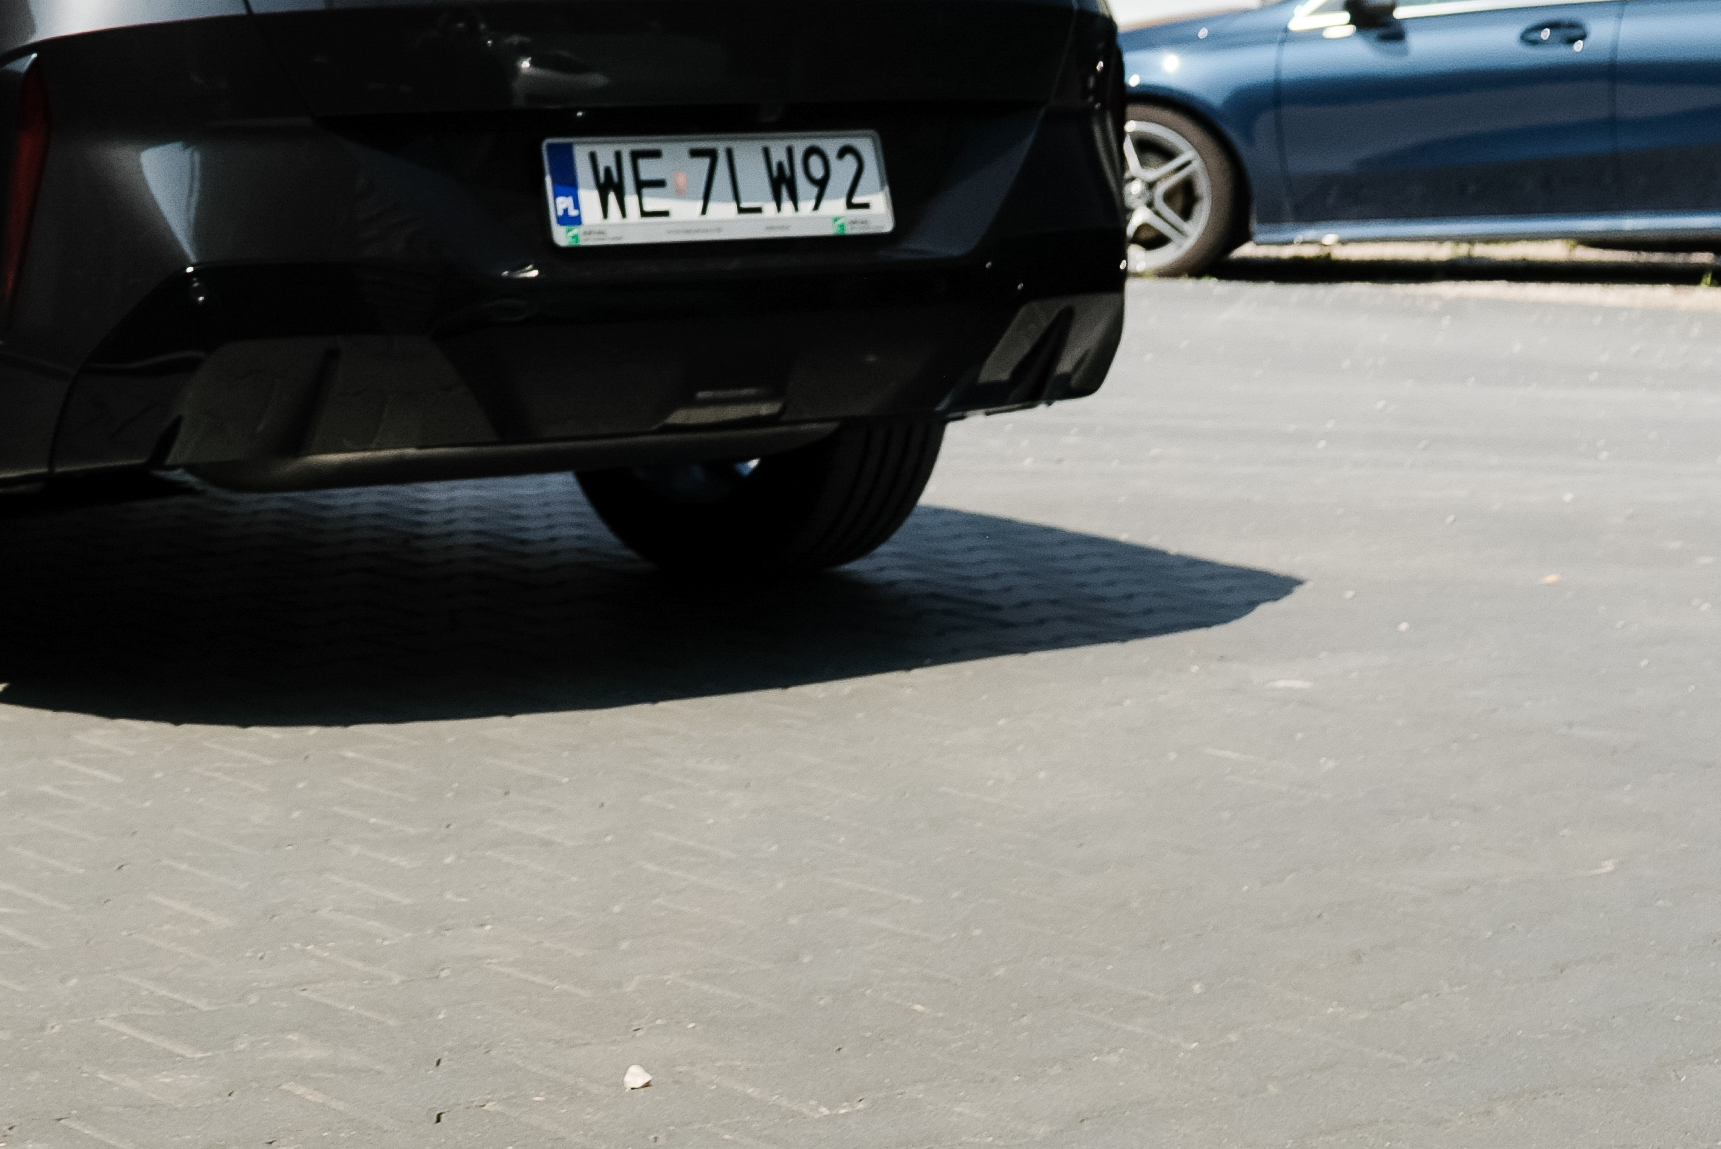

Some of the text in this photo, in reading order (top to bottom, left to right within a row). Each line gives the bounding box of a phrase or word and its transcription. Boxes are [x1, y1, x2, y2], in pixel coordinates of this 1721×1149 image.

[589, 144, 871, 220] WE 7LW92
[555, 196, 579, 218] PL
